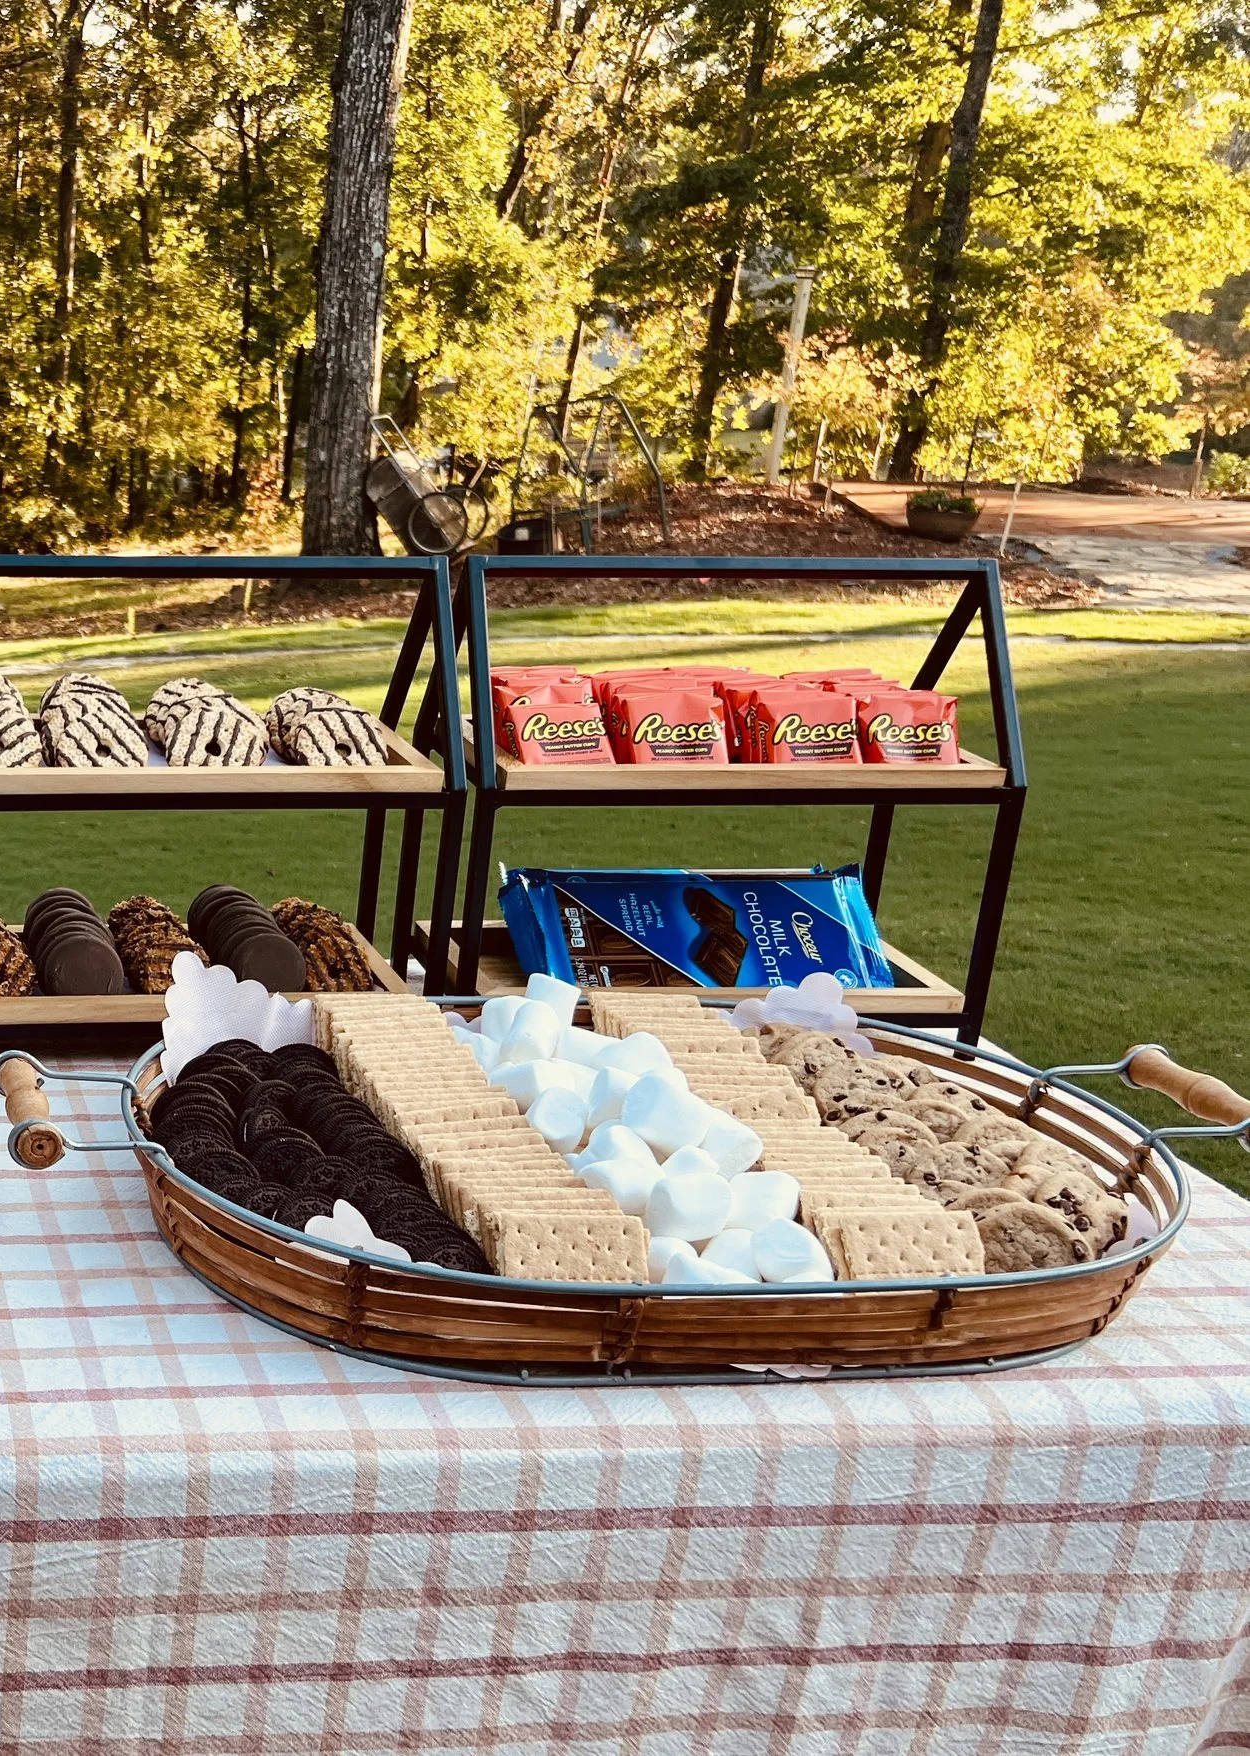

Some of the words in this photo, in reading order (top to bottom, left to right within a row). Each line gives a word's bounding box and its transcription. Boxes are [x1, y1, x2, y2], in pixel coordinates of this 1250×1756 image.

[521, 713, 607, 742] Reese's
[633, 713, 722, 744] Reese's
[867, 713, 953, 744] Reese's
[618, 898, 633, 932] SPREAD
[629, 893, 646, 937] HAZELNUT
[642, 904, 654, 925] REAL
[743, 891, 784, 986] CHOCOLATE
[769, 919, 792, 957] MILK
[791, 911, 824, 965] Choceur
